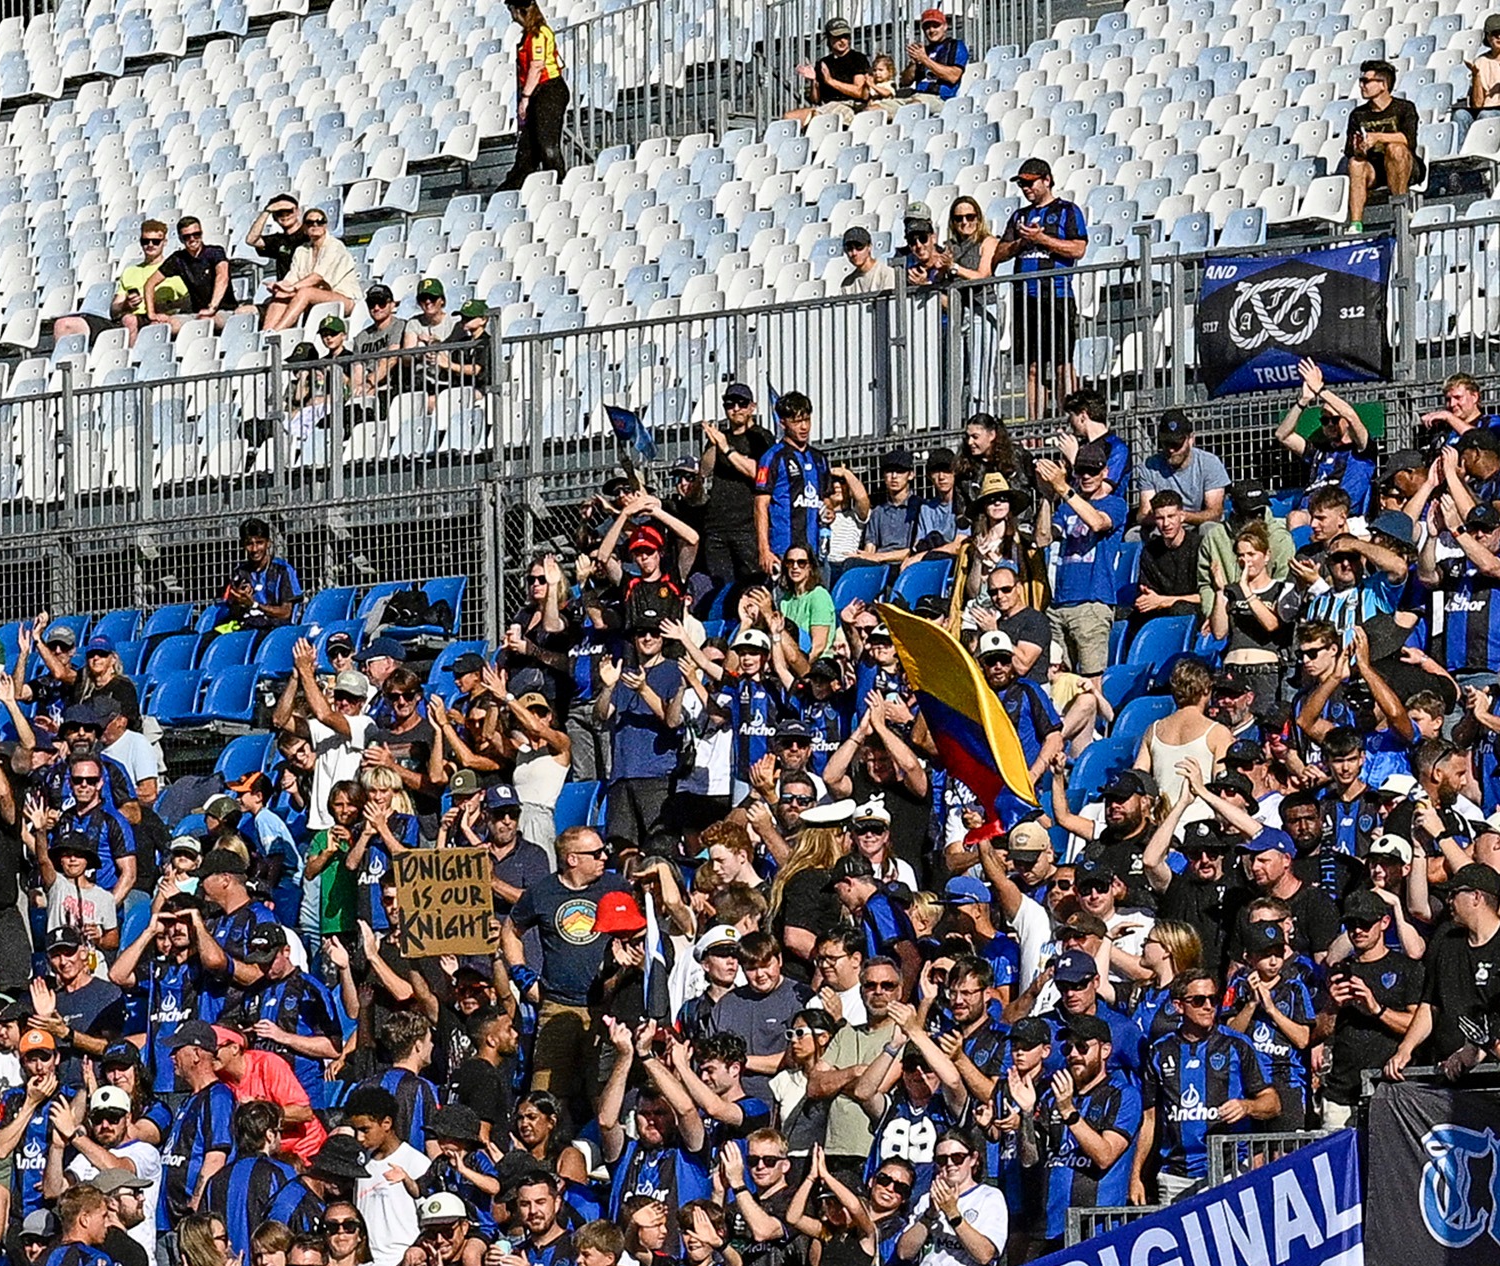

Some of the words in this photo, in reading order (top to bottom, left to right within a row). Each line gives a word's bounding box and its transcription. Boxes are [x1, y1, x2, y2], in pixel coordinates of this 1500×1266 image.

[1205, 265, 1238, 280] AND
[1348, 245, 1381, 265] IT'S
[1339, 306, 1366, 320] 312
[1253, 364, 1300, 384] TRUE
[739, 722, 776, 737] Ancho
[438, 885, 487, 906] OUR
[1168, 1104, 1220, 1122] Ancho
[880, 1115, 938, 1163] 89
